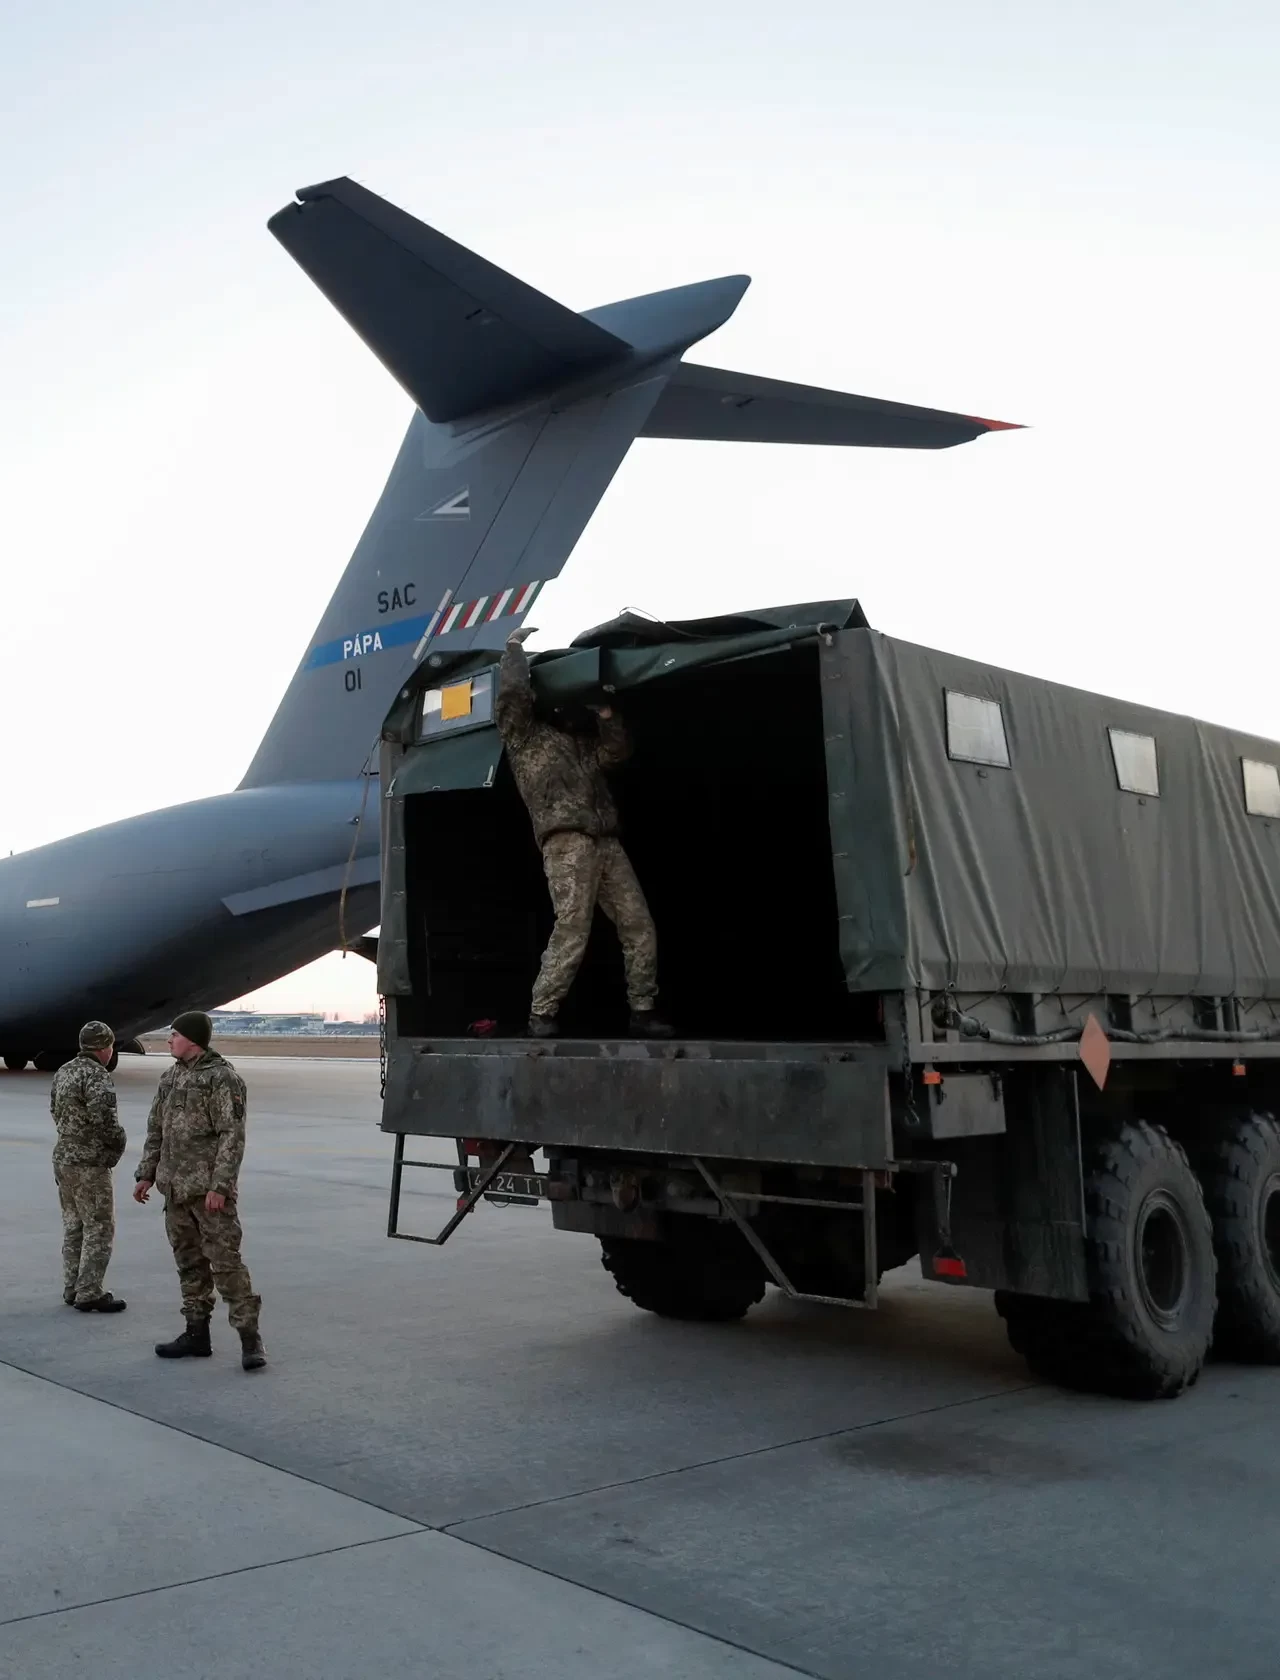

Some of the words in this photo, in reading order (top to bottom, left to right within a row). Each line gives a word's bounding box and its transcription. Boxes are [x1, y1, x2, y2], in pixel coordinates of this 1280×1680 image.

[378, 583, 416, 614] SAC
[343, 632, 383, 659] PÁPA
[344, 668, 362, 692] 01
